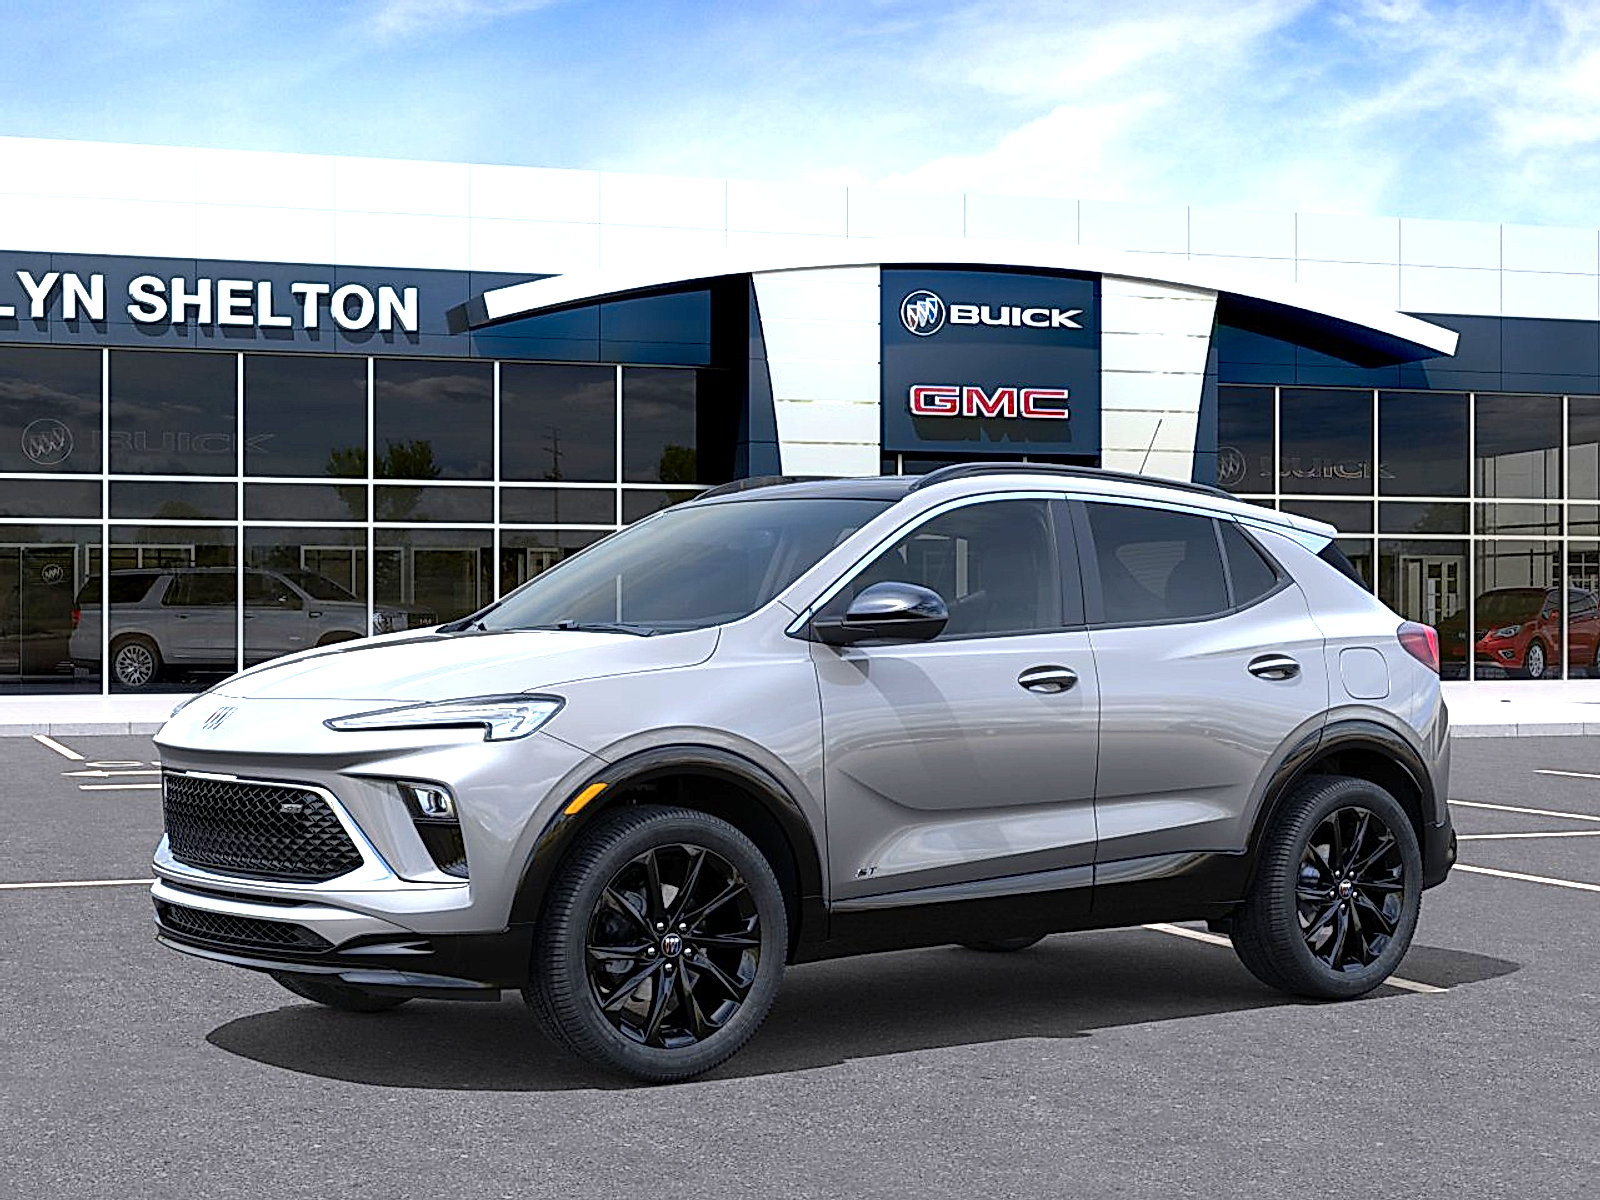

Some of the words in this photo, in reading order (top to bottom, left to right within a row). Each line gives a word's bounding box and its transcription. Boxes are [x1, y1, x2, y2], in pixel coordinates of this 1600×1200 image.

[127, 274, 418, 331] SHELTON
[950, 304, 1083, 329] BUICK
[910, 385, 1069, 419] GMC
